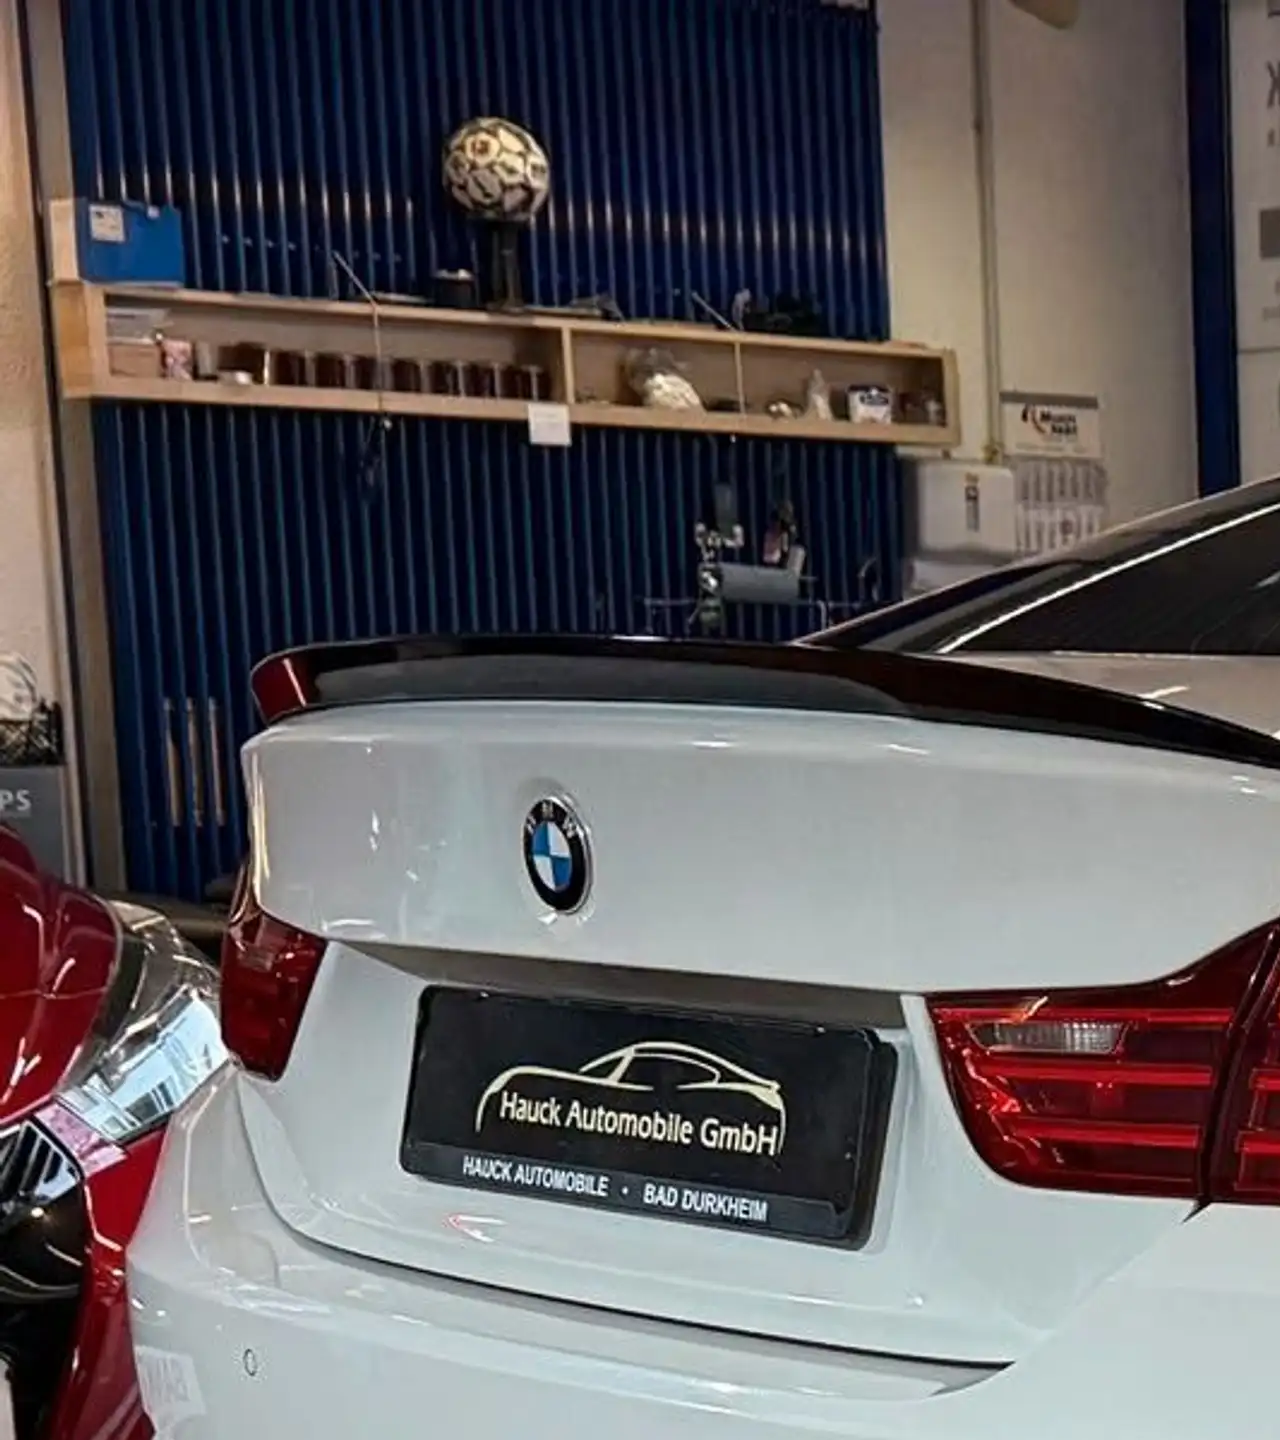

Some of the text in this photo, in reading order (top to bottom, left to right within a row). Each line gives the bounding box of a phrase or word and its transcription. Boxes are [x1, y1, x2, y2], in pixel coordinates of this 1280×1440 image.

[500, 1090, 778, 1156] Hauck Automobile GmbH
[462, 1155, 513, 1183] HAUCK
[514, 1163, 611, 1198] AUTOMOBILE
[643, 1183, 679, 1208] BAD
